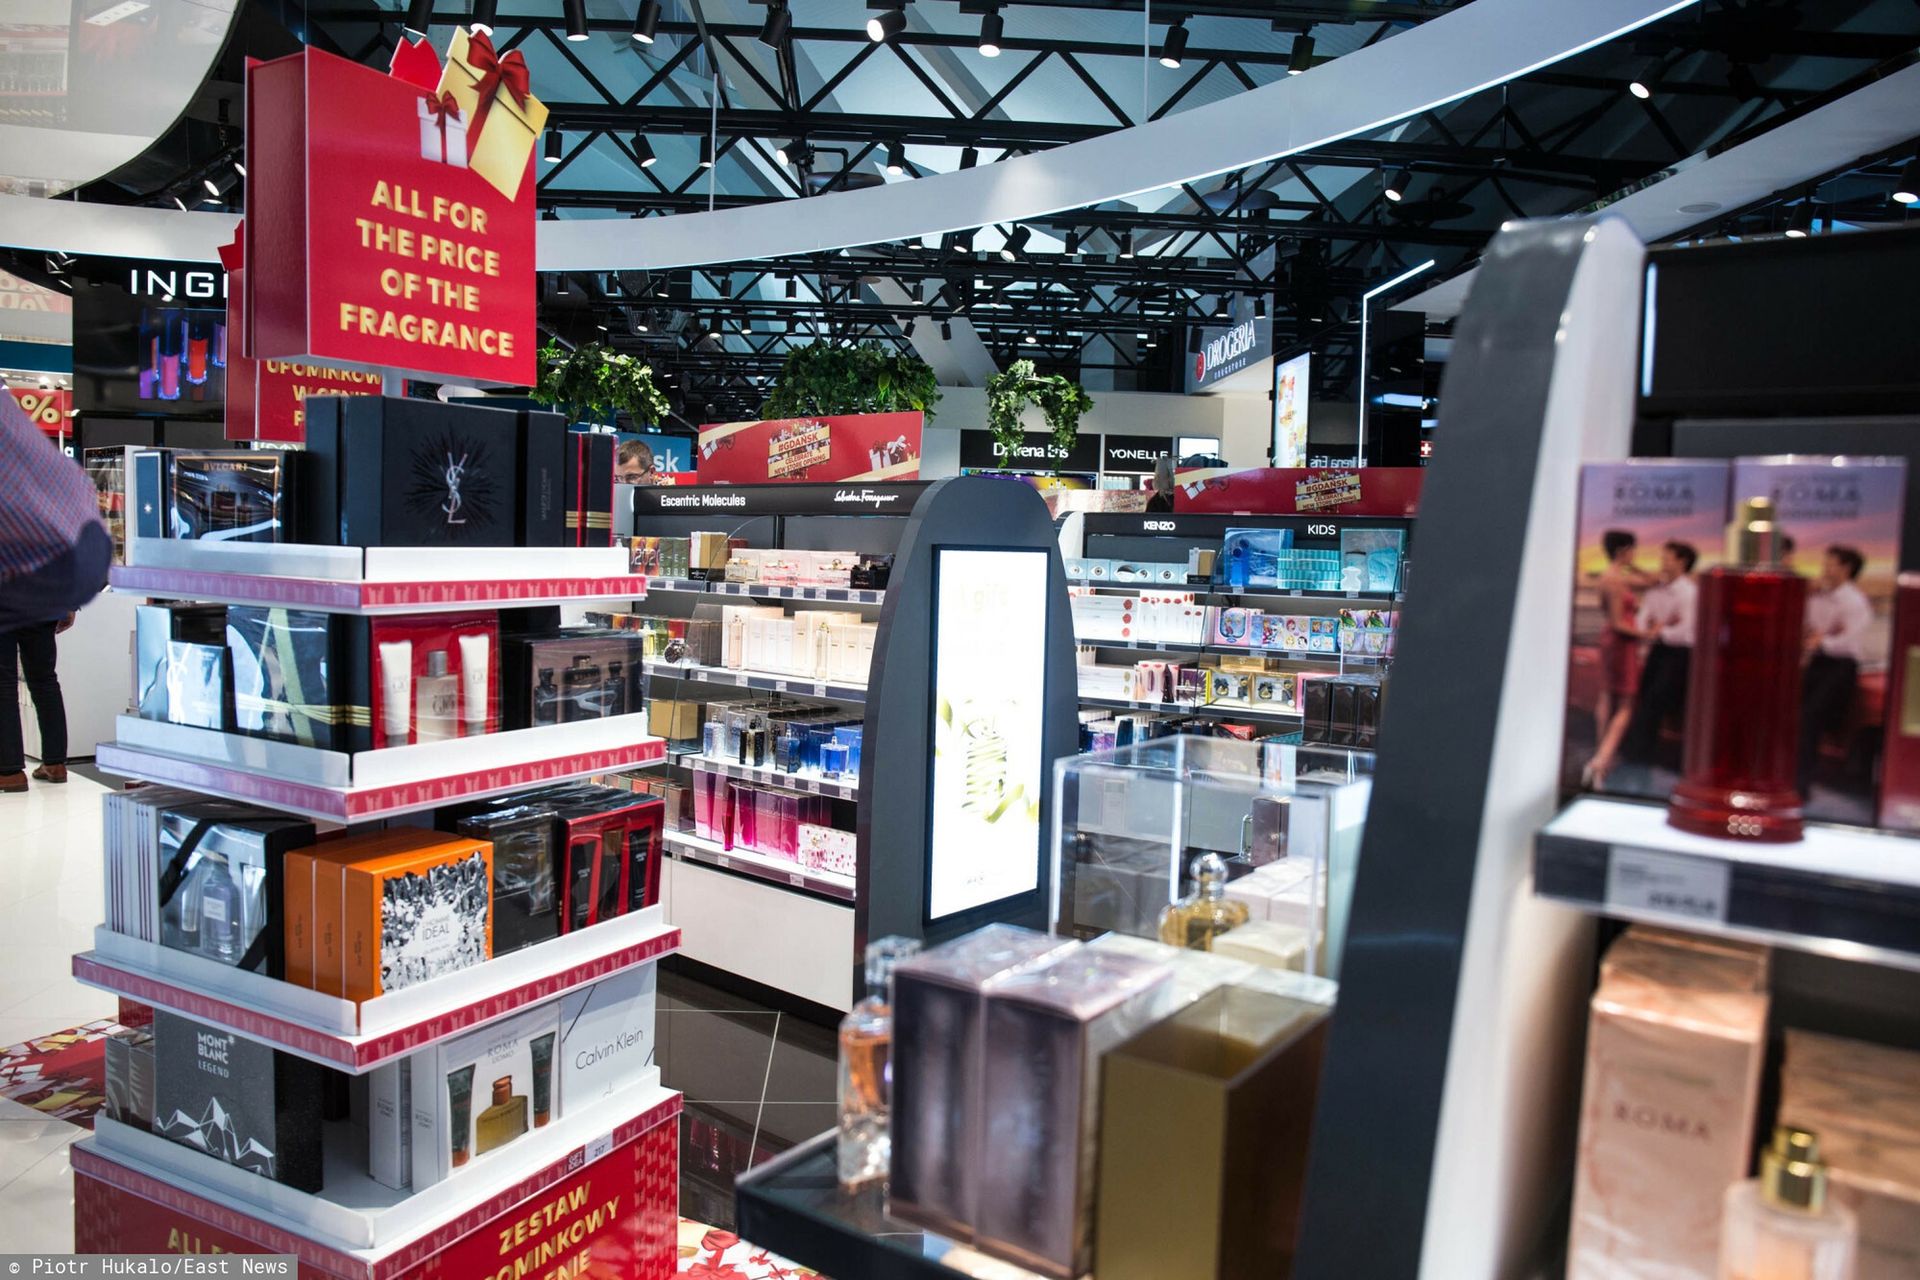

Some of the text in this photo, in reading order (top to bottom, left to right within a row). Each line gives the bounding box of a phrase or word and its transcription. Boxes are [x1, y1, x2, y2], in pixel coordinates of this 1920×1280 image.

[371, 180, 488, 234] ALL FOR
[356, 218, 500, 277] THE PRICE
[380, 268, 480, 312] OF THE
[340, 302, 514, 358] FRAGRANCE
[1207, 319, 1256, 371] DROGERIA
[660, 493, 746, 507] Escentric Molecules
[1143, 520, 1176, 531] KENZO
[1307, 524, 1336, 535] KIDS
[422, 922, 450, 941] IDEAL
[197, 1031, 228, 1051] MONT
[198, 1043, 229, 1064] BLANC
[575, 1028, 644, 1070] Calvin Klein
[198, 1059, 229, 1078] LEGEND
[484, 1195, 620, 1280] OMINKOWY
[499, 1181, 591, 1255] ZESTAW
